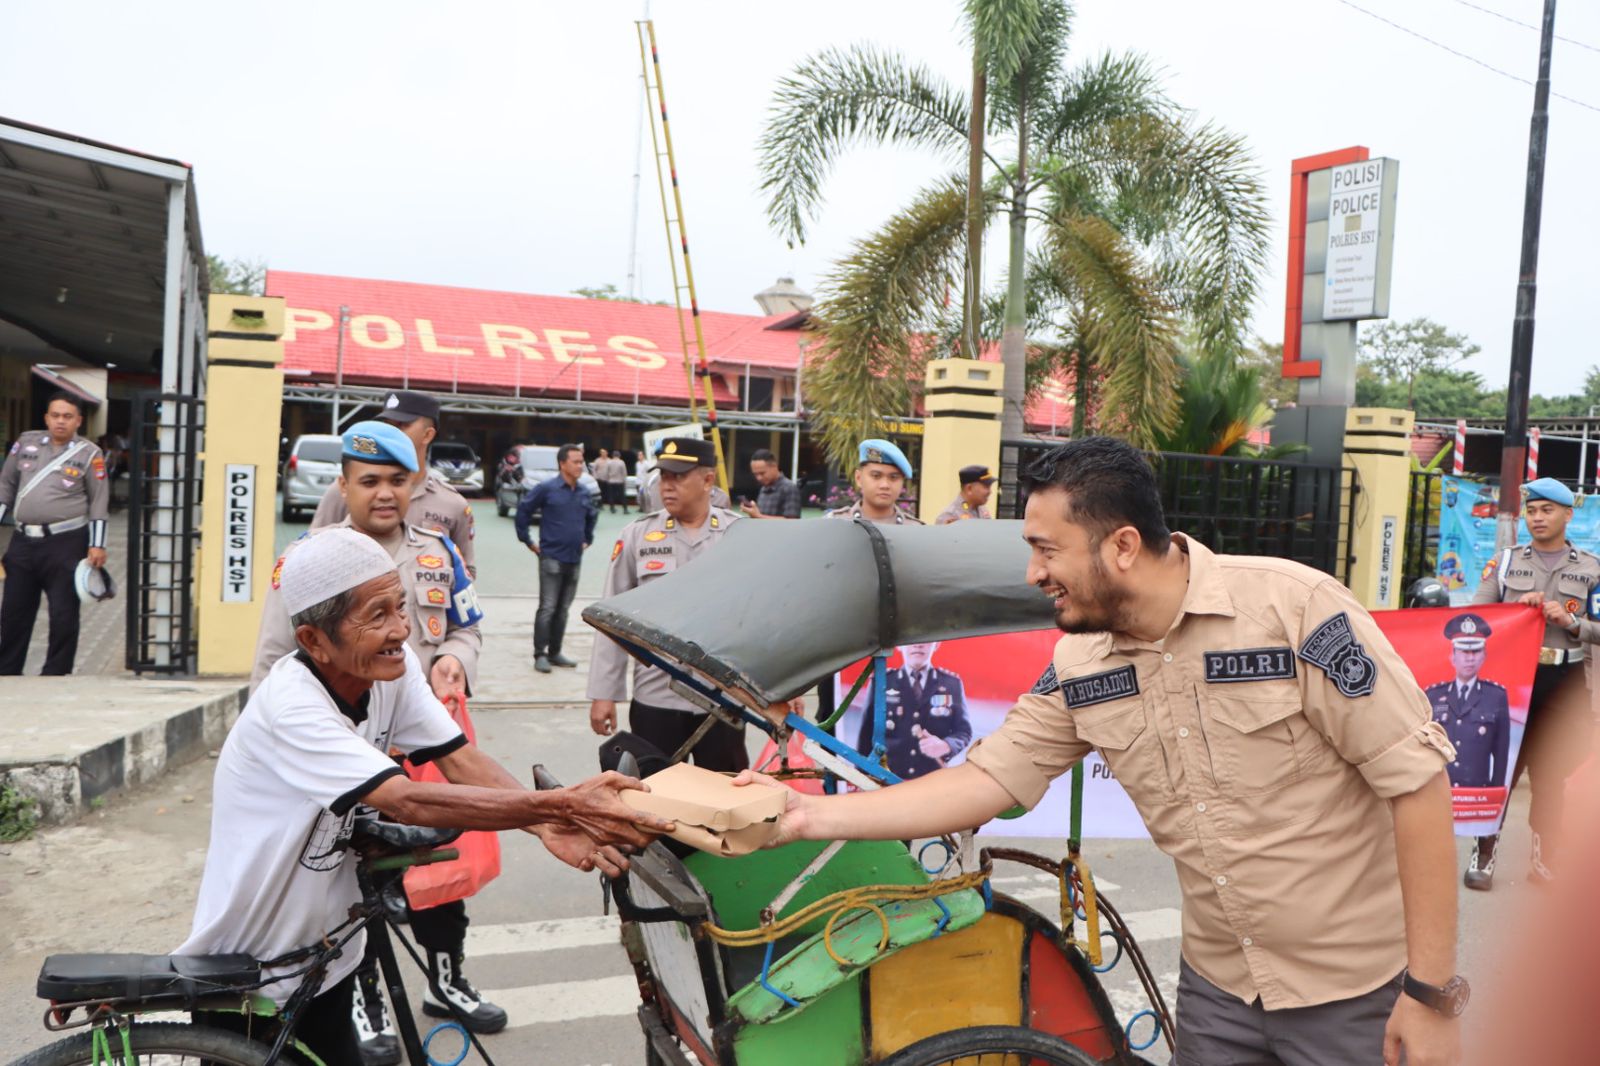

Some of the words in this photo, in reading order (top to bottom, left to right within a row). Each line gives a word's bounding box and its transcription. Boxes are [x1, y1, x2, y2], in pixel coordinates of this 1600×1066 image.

[1334, 164, 1380, 188] POLISI
[1332, 193, 1378, 216] POLICE
[1330, 231, 1359, 248] POLRES
[1360, 229, 1375, 244] HST
[285, 307, 667, 370] POLRES
[229, 472, 249, 549] POLRES
[1382, 521, 1393, 572] POLRES
[229, 556, 247, 593] HST
[416, 571, 450, 583] POLRI
[1560, 573, 1590, 584] POLRI
[1379, 576, 1388, 600] HST
[1210, 653, 1287, 676] POLRI
